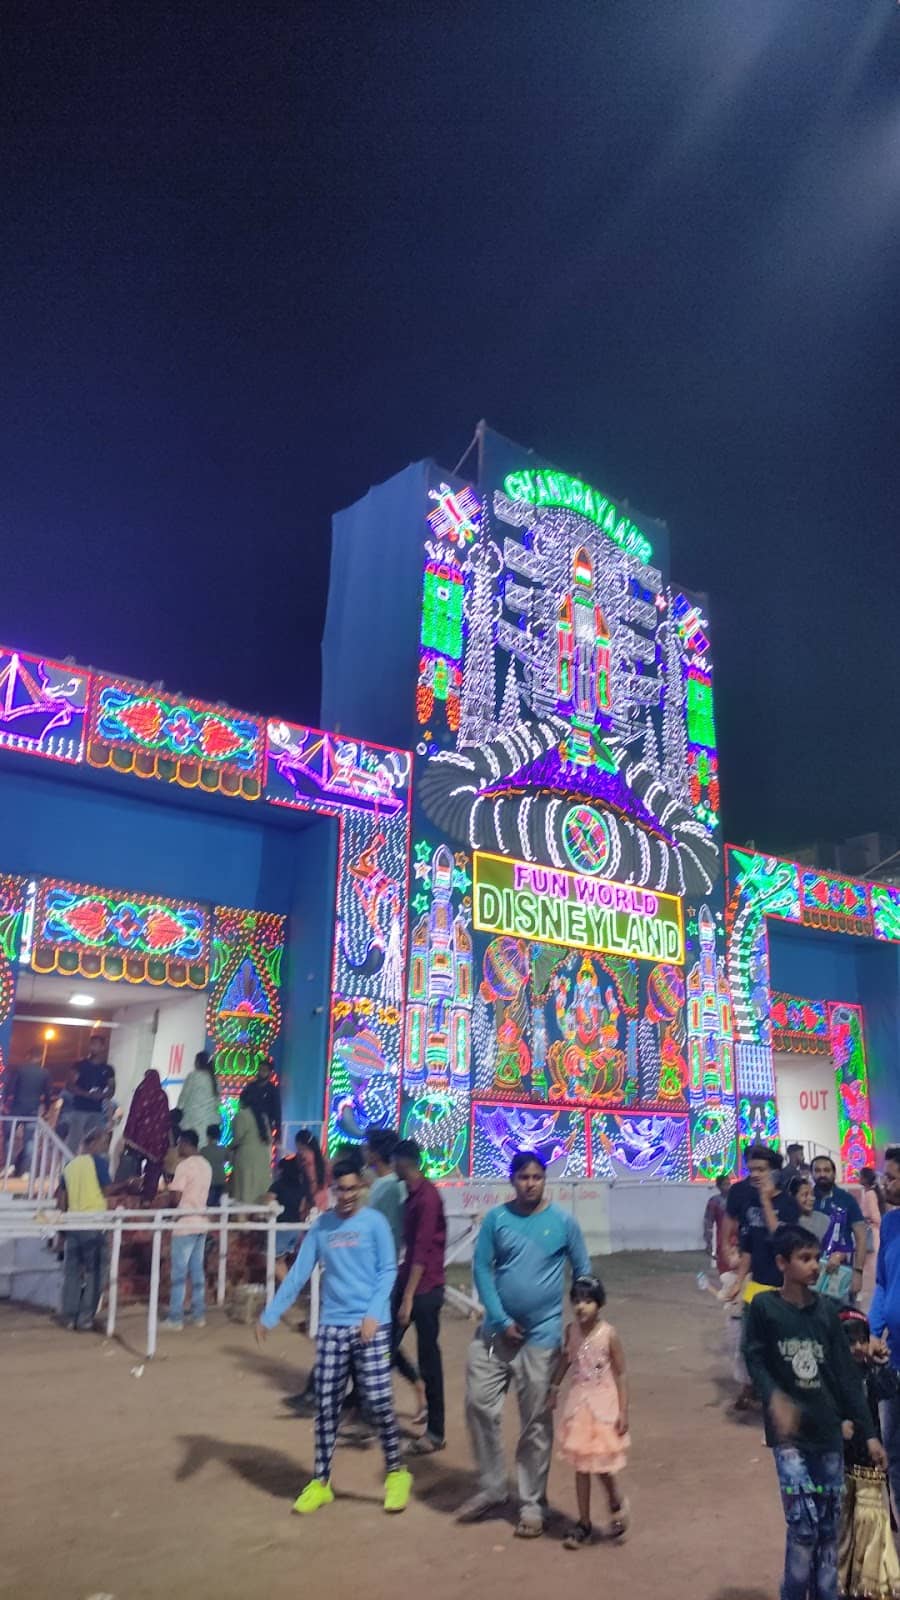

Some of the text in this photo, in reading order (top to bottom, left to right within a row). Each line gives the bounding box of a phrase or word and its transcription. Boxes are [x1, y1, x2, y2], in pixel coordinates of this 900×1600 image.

[513, 863, 659, 917] FUN WORLD
[476, 882, 682, 961] DISNEYLAND
[168, 1043, 185, 1074] IN
[799, 1090, 829, 1111] OUT
